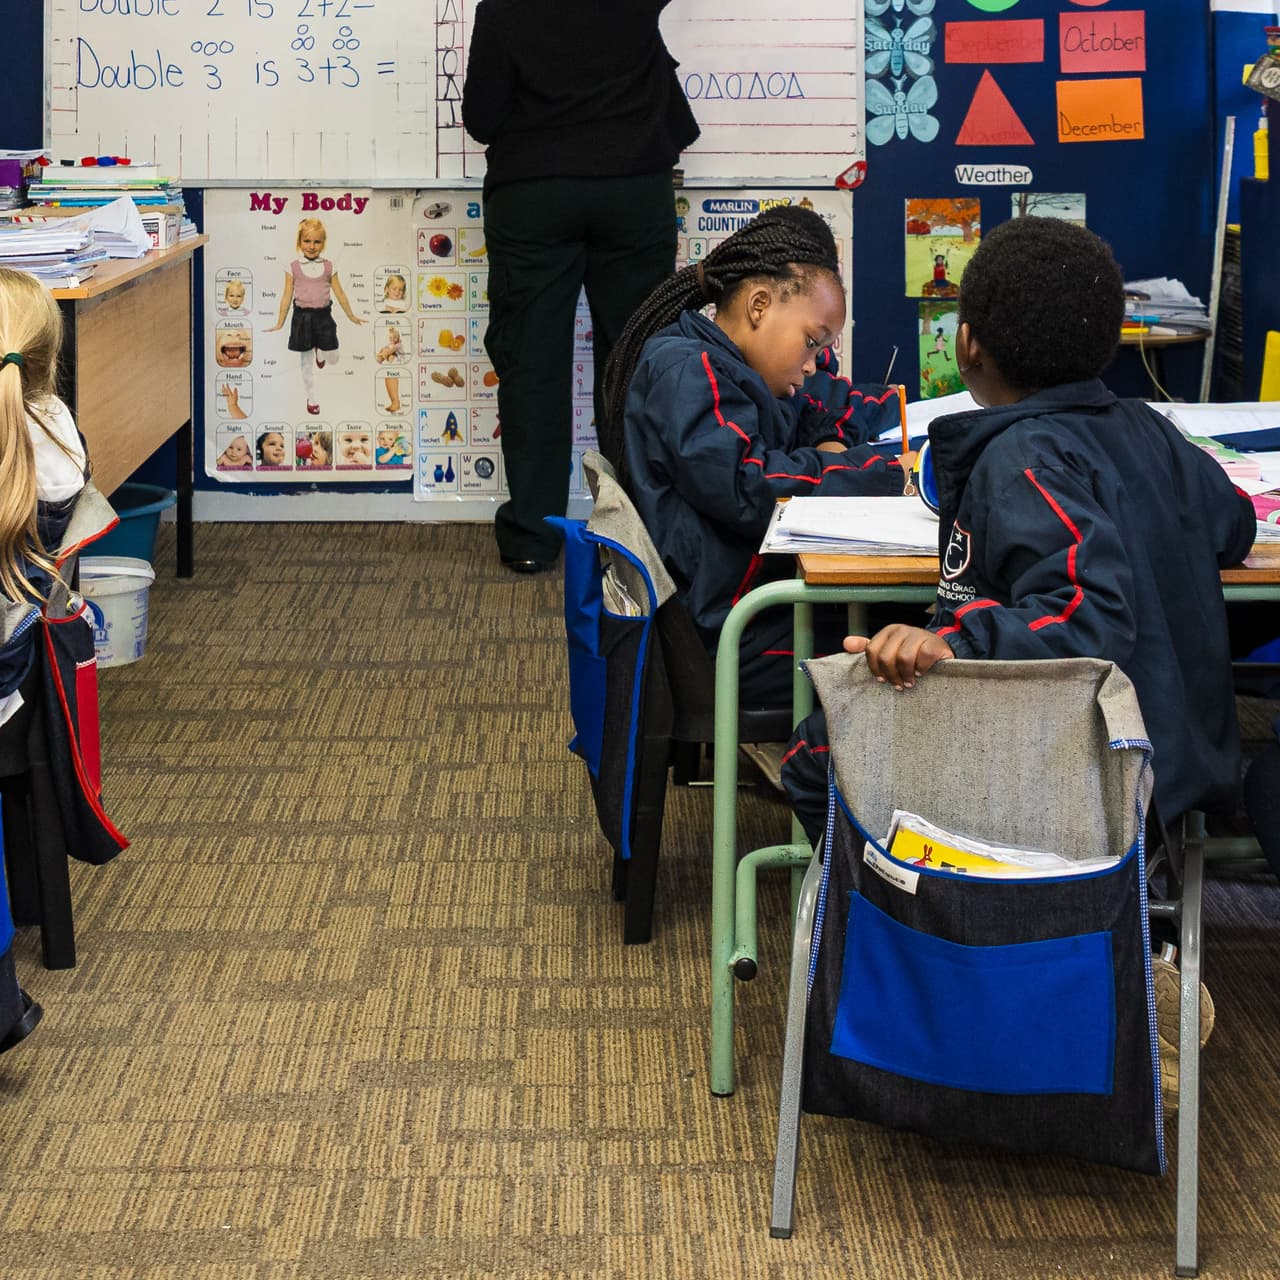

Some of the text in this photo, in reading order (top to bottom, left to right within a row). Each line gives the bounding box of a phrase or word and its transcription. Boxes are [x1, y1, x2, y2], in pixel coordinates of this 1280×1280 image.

[1064, 21, 1144, 53] October
[76, 36, 184, 90] Double
[203, 64, 222, 90] 3
[256, 57, 279, 87] is
[1060, 112, 1141, 136] December
[956, 167, 1031, 183] Weather
[250, 192, 369, 215] My Body
[709, 201, 753, 211] MARLIN
[224, 321, 244, 329] Mouth
